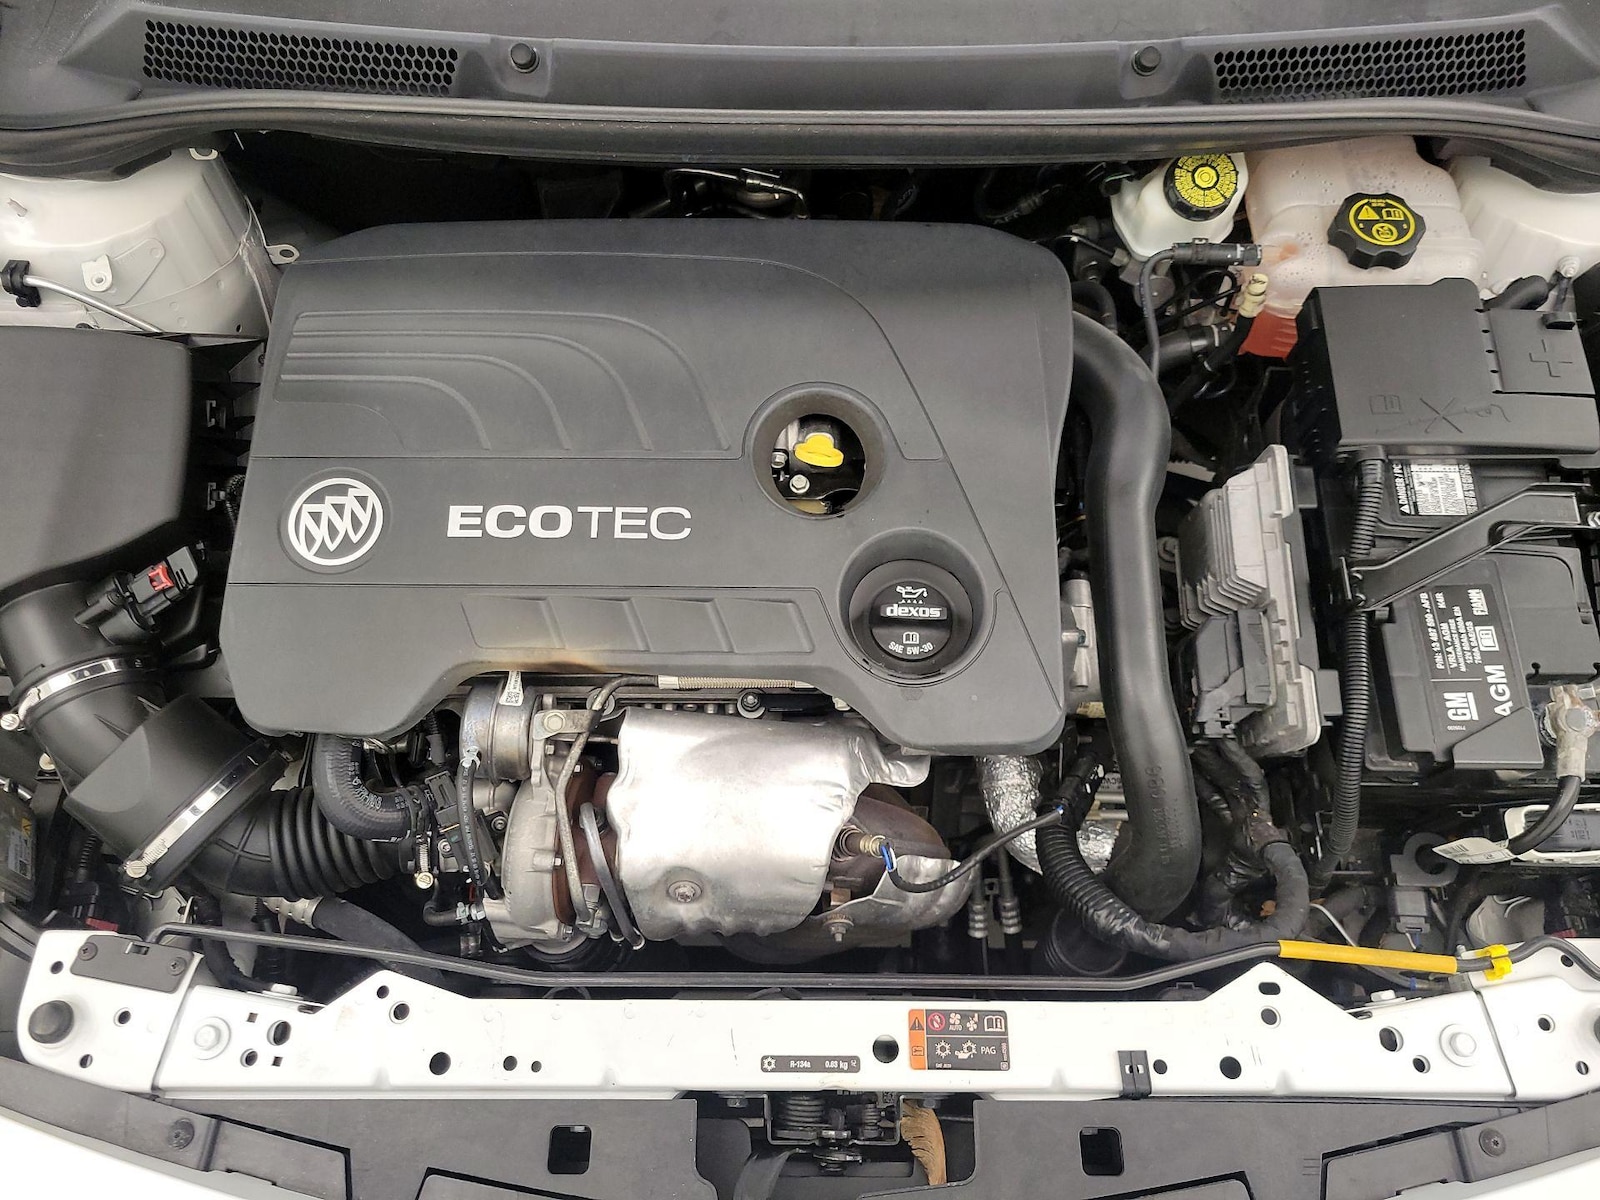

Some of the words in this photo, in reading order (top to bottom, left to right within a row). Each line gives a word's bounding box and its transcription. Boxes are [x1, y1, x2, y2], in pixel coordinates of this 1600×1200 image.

[1394, 477, 1409, 505] DANGER
[447, 504, 692, 541] ECOTEC
[886, 603, 942, 618] dexos
[1467, 588, 1487, 616] FIAMM
[1440, 622, 1452, 642] AGM
[888, 641, 904, 654] SAE
[906, 642, 934, 655] 5W-30
[1484, 664, 1514, 717] AGM
[1443, 692, 1472, 721] GM
[980, 1046, 997, 1055] PAG
[790, 1060, 811, 1069] R-134a
[839, 1060, 849, 1071] kg
